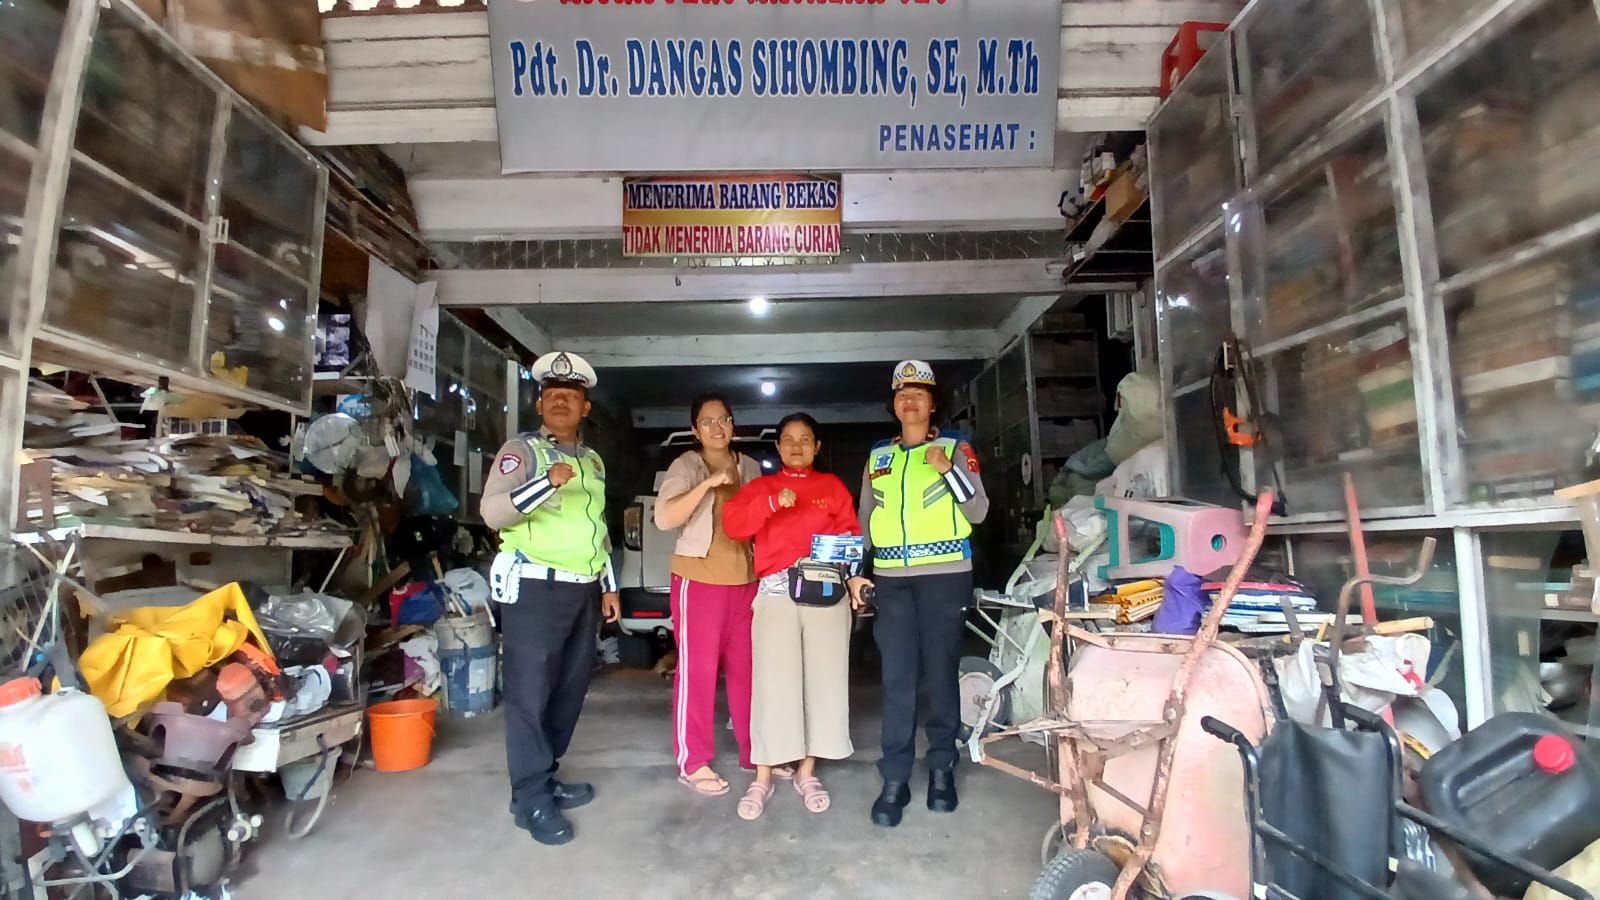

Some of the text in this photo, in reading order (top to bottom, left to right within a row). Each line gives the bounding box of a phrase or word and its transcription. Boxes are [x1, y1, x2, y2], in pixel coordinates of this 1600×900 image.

[510, 38, 1039, 108] Pdt. Dr. DANGAS SIHOMBING, SE, M.Th
[879, 123, 1020, 151] PENASEHAT
[628, 181, 838, 210] MENERIMA BARANG BEKAS
[623, 225, 661, 254] TIDAK
[665, 225, 734, 254] MENERIMA
[737, 224, 791, 254] BARANG
